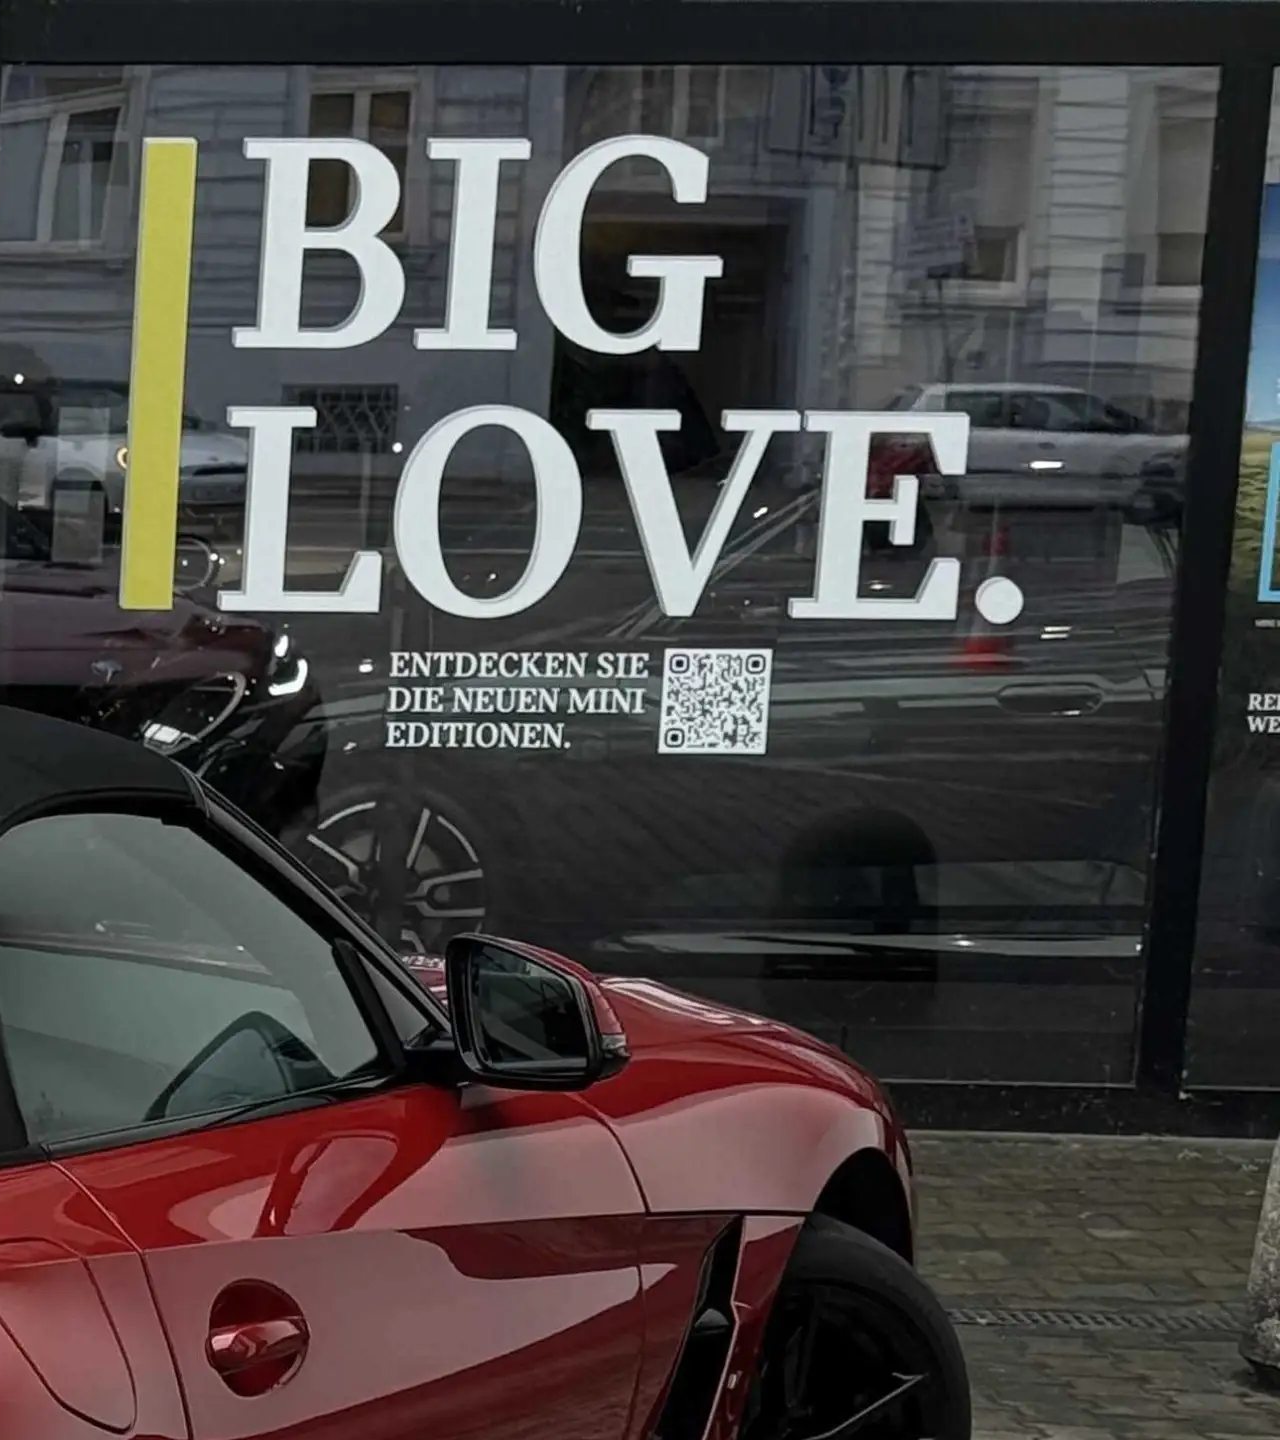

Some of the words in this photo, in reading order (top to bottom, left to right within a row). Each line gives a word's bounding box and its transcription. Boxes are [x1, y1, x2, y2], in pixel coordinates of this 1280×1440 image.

[232, 134, 724, 355] BIG
[217, 404, 1024, 624] LOVE.
[390, 652, 589, 678] ENTDECKEN
[596, 652, 650, 678] SIE
[387, 686, 444, 713] DIE
[452, 687, 561, 713] NEUEN
[567, 687, 646, 714] MINI
[385, 722, 572, 749] EDITIONEN.
